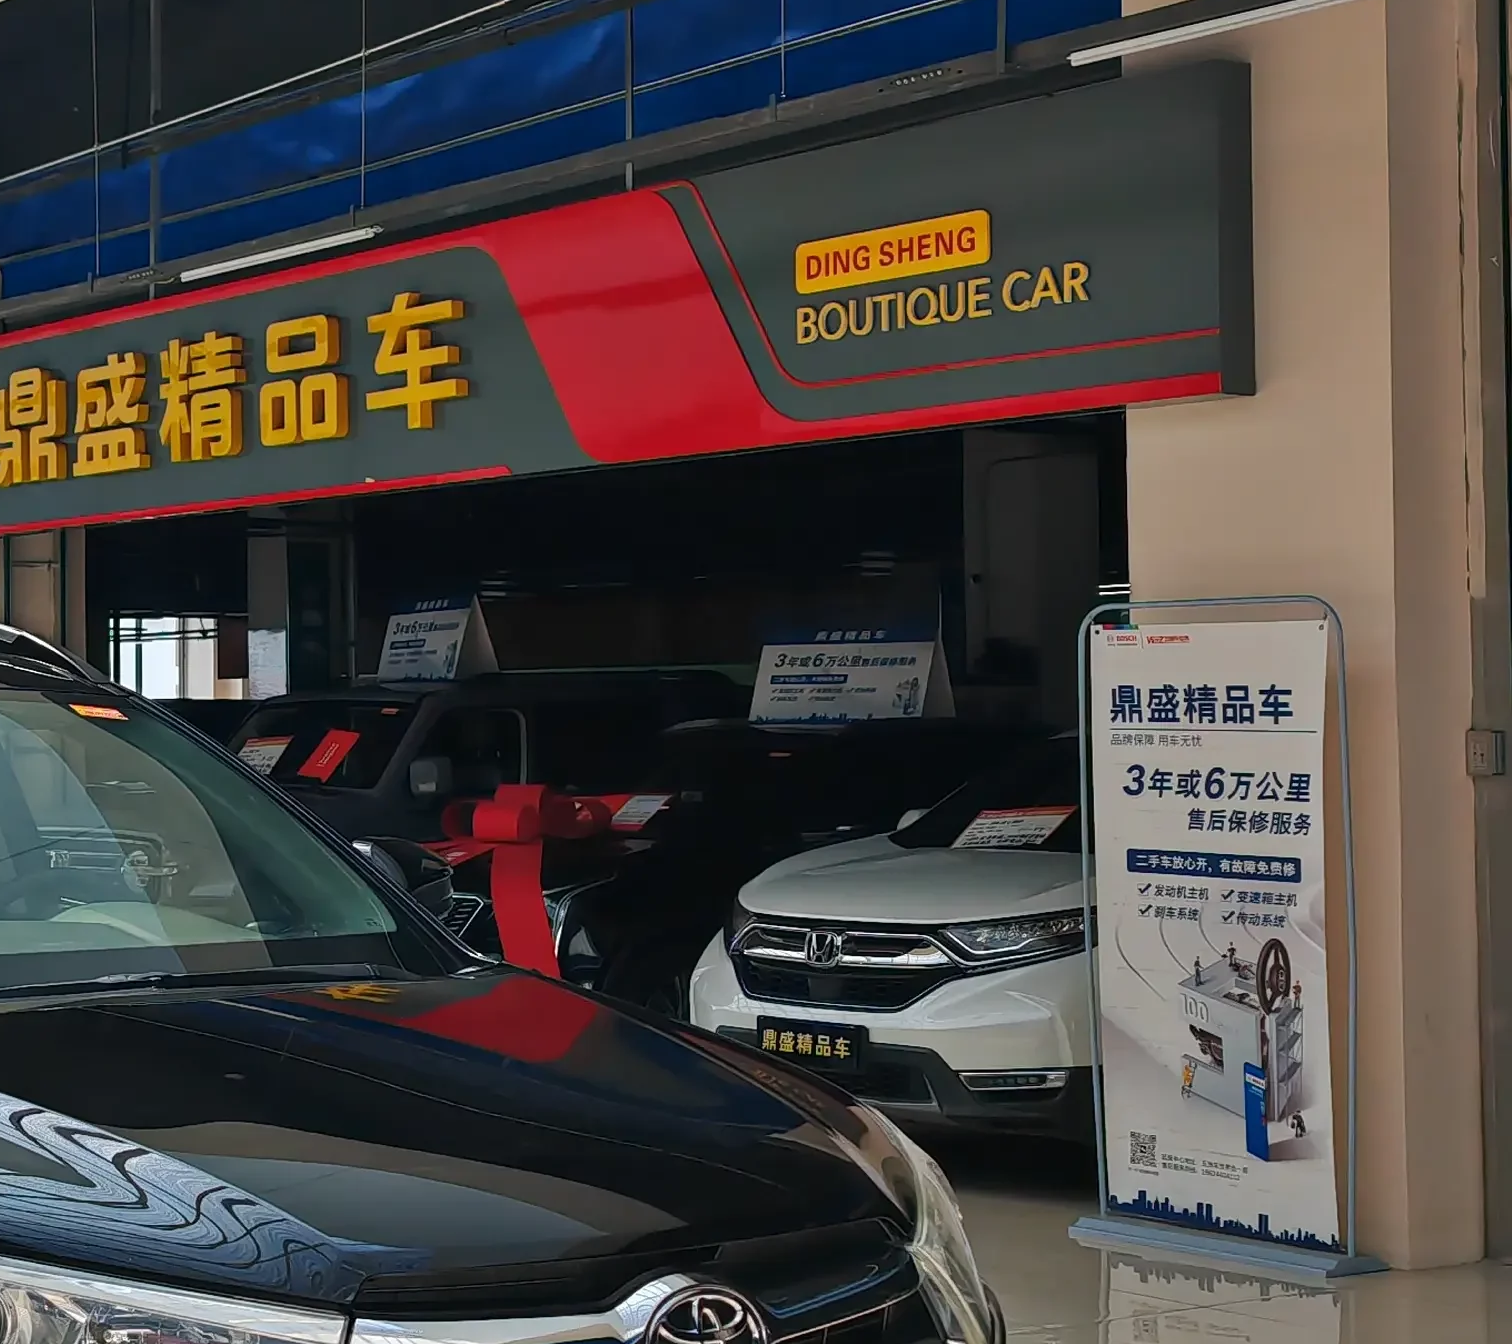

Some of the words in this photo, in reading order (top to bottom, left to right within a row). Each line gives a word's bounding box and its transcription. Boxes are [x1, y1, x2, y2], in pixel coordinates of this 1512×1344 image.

[805, 244, 871, 281] DING
[878, 225, 977, 268] SHENG
[795, 276, 992, 346] BOUTIQUE
[1001, 261, 1090, 314] CAR
[1110, 684, 1294, 725] 鼎盛精品车
[1110, 733, 1155, 747] 品牌保障
[1158, 734, 1203, 747] 用车无忧
[1121, 763, 1312, 803] 3年或6万公里
[1187, 807, 1312, 837] 售后保修服务
[761, 1028, 852, 1060] 鼎盛精品车
